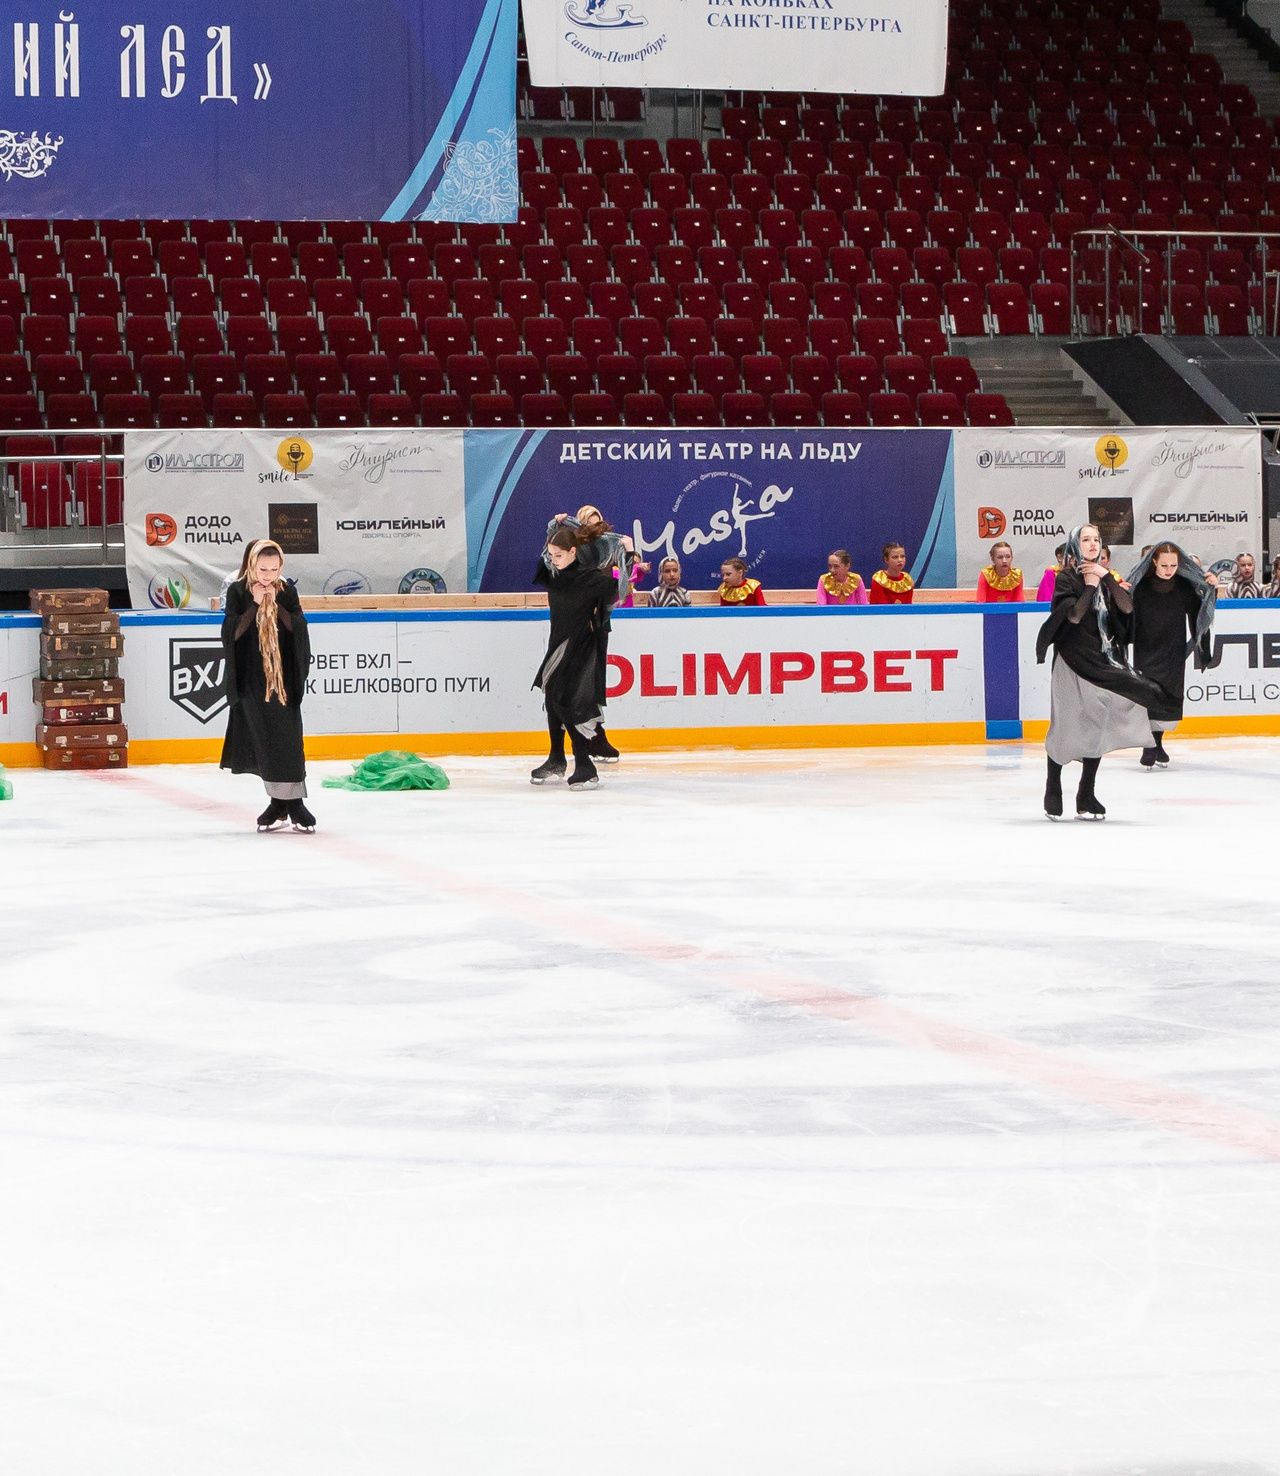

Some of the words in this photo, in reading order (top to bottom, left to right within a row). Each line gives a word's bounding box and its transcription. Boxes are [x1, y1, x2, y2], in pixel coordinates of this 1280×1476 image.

[707, 13, 902, 33] САНКТ-ПЕТЕРБУРГА
[564, 31, 669, 63] Санкт-Петербург
[560, 439, 671, 463] ДЕТСКИЙ
[679, 443, 753, 461] ТЕАТР
[761, 443, 793, 460] НА
[800, 442, 862, 463] ЛЬДУ
[258, 468, 292, 484] smile
[1078, 464, 1109, 479] smile
[185, 515, 231, 529] ДОДО
[336, 516, 446, 530] ЮБИЛЕЙНЫЙ
[1013, 509, 1054, 522] ДОДО
[1149, 510, 1248, 523] ЮБИЛЕЙНЫЙ
[185, 532, 243, 545] ПИЦЦА
[1013, 525, 1065, 537] ПИЦЦА
[357, 654, 391, 669] ВХЛ
[324, 677, 437, 694] ШЕЛКОВОГО
[445, 676, 490, 693] ПУТИ
